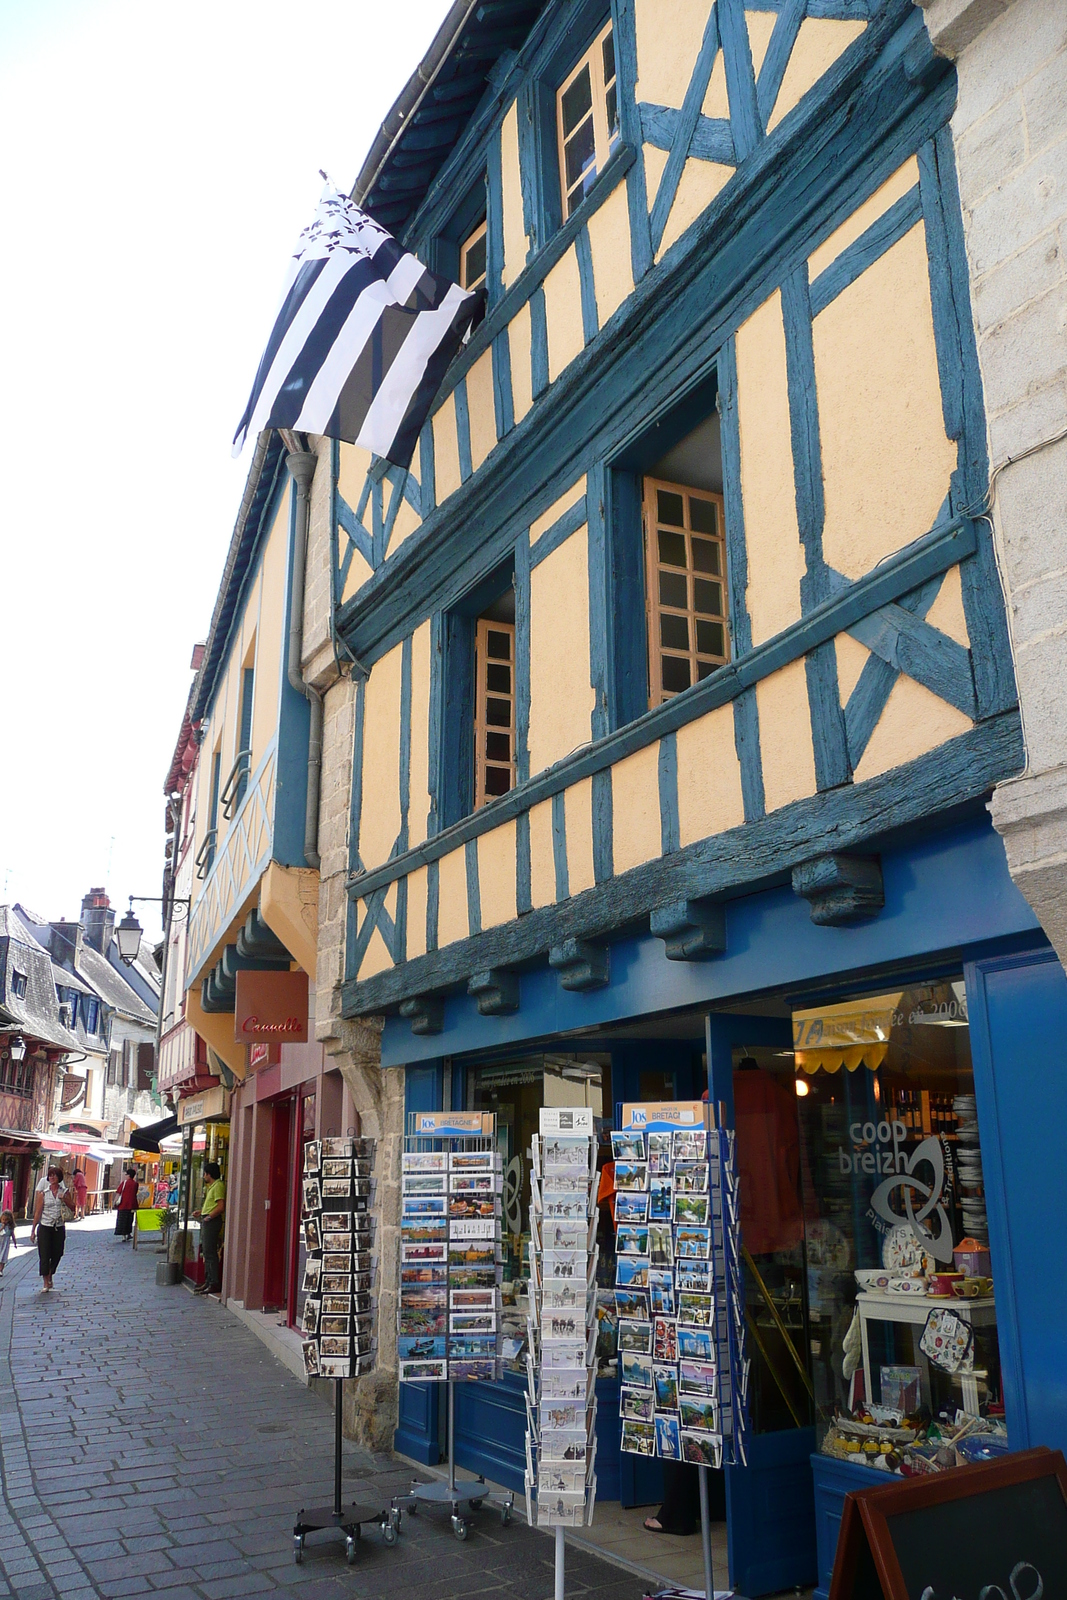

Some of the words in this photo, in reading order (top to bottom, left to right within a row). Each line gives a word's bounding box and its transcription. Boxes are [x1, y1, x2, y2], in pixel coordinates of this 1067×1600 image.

[930, 1000, 968, 1021] 2006
[242, 1015, 303, 1033] Cannelle
[652, 1112, 681, 1120] BRETAG
[849, 1120, 907, 1150] coop
[838, 1143, 912, 1174] breizh
[865, 1208, 906, 1238] Plaisirs
